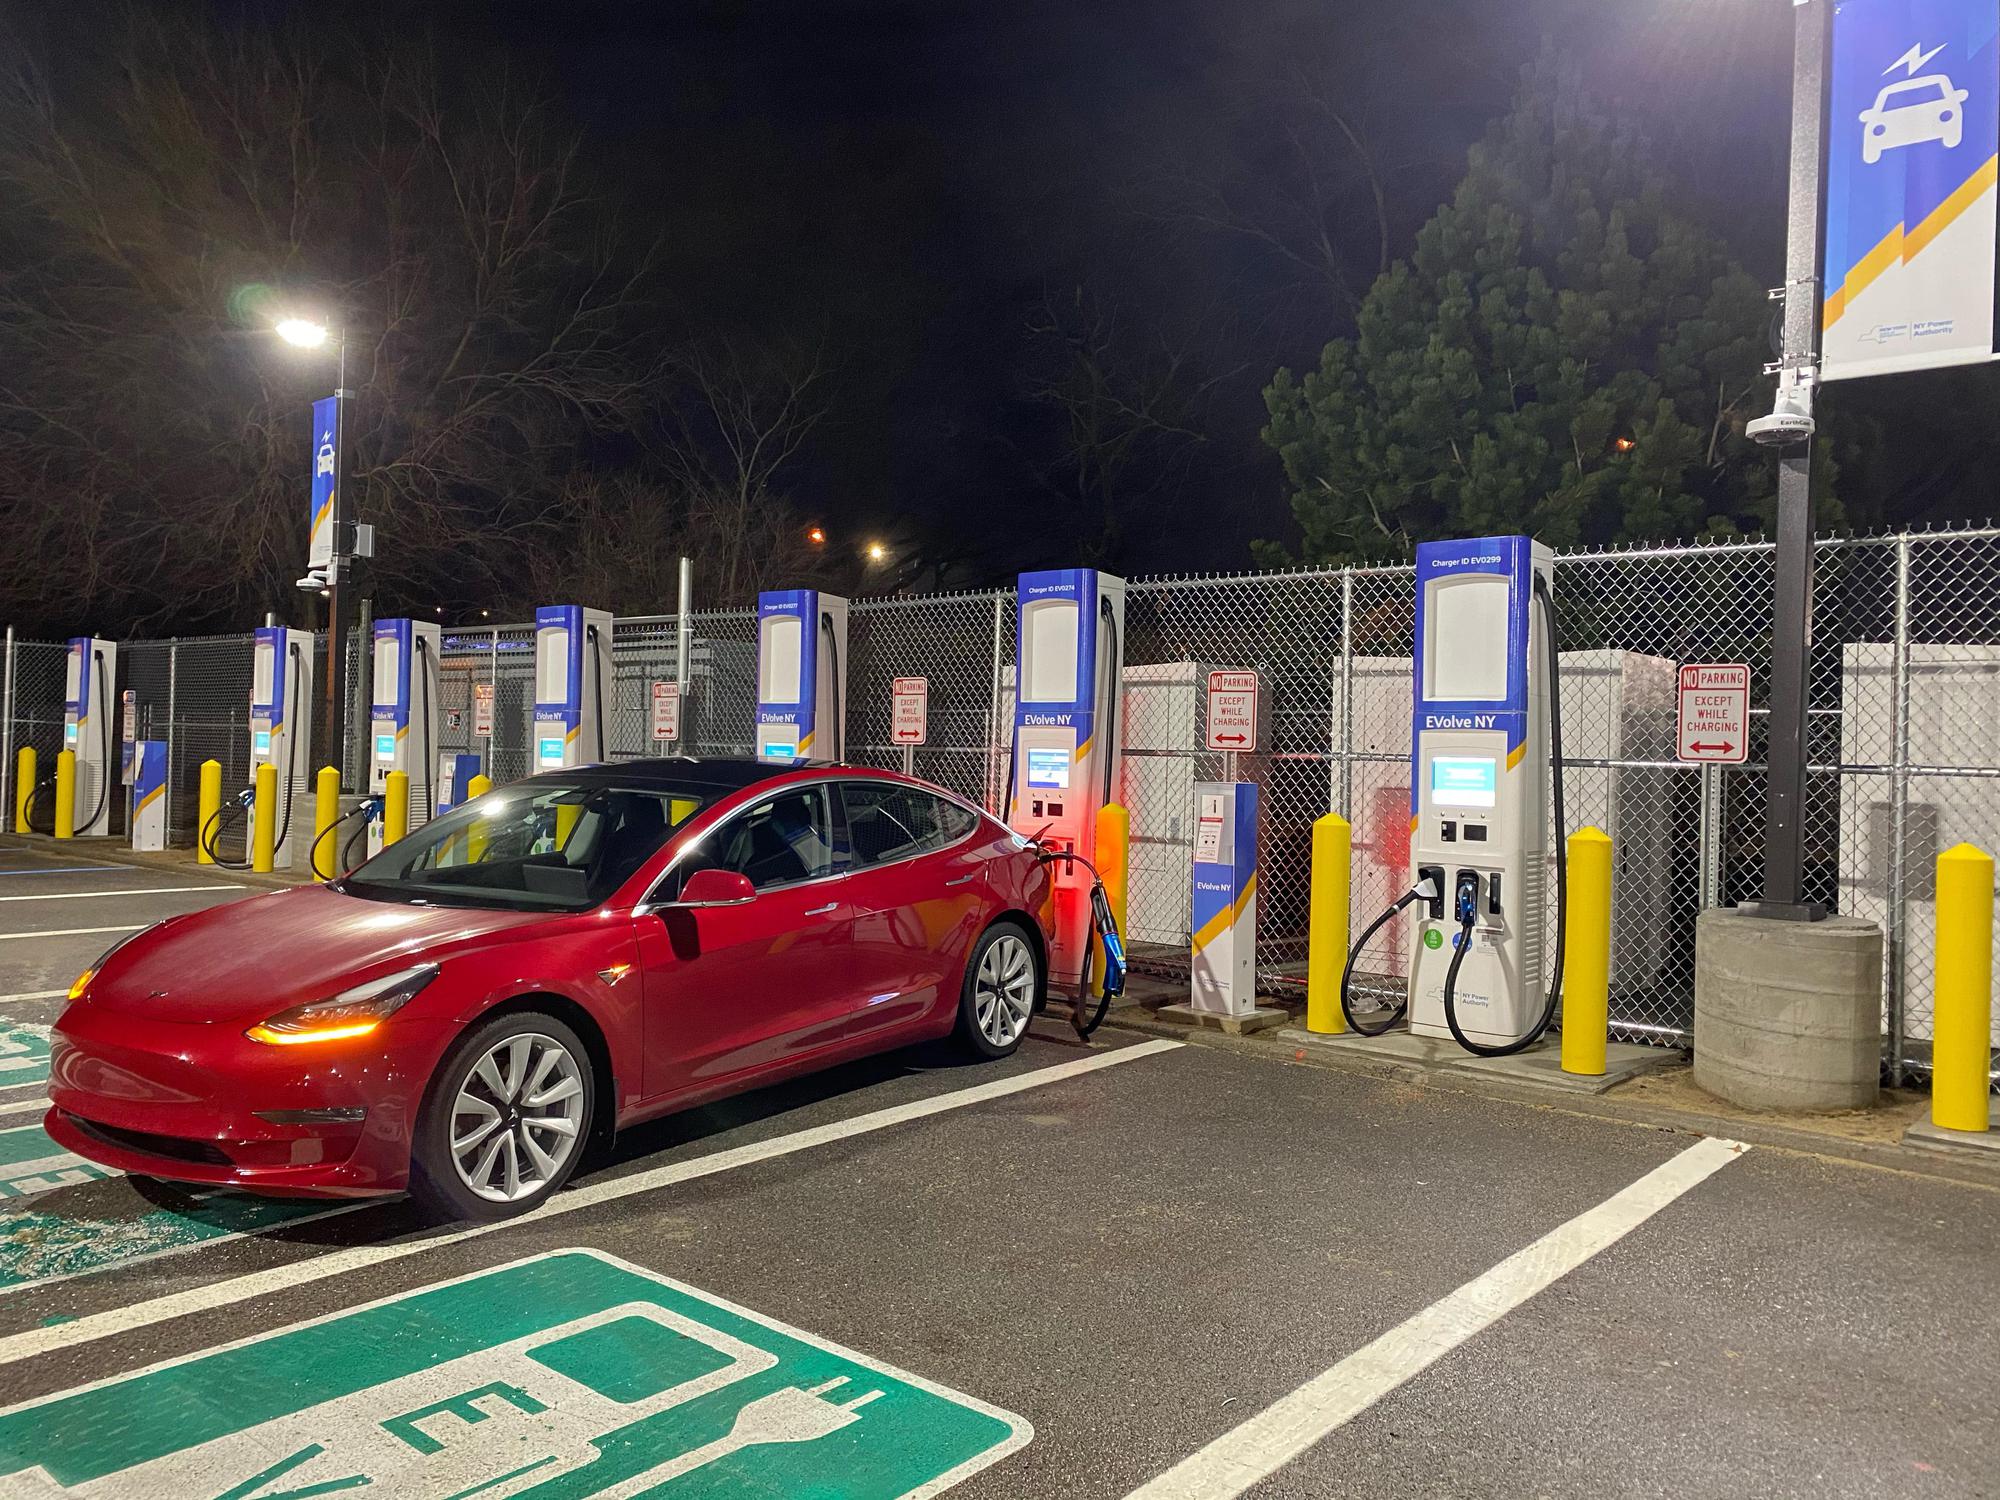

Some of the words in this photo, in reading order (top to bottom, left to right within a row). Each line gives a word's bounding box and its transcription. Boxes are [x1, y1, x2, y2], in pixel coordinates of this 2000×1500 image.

[1913, 322, 1926, 330] NY
[1914, 326, 1953, 337] Authority
[1471, 556, 1501, 564] EV0299
[1211, 675, 1221, 690] NO
[1224, 678, 1253, 687] PARKING
[1683, 670, 1698, 688] NO
[1701, 673, 1743, 684] PARKING
[904, 683, 923, 691] PARKING
[1695, 696, 1732, 706] EXCEPT
[536, 712, 553, 720] EVolve
[761, 714, 784, 722] EVolve
[784, 714, 796, 722] NY
[1697, 710, 1728, 718] WHILE
[1025, 714, 1055, 725] EVolve
[1057, 715, 1072, 725] NY
[1214, 718, 1250, 726] CHARGING
[1426, 716, 1471, 729] EVolve
[1475, 716, 1496, 729] NY
[1687, 722, 1738, 732] CHARGING
[1197, 882, 1220, 891] EVolve
[1462, 999, 1489, 1008] Authority
